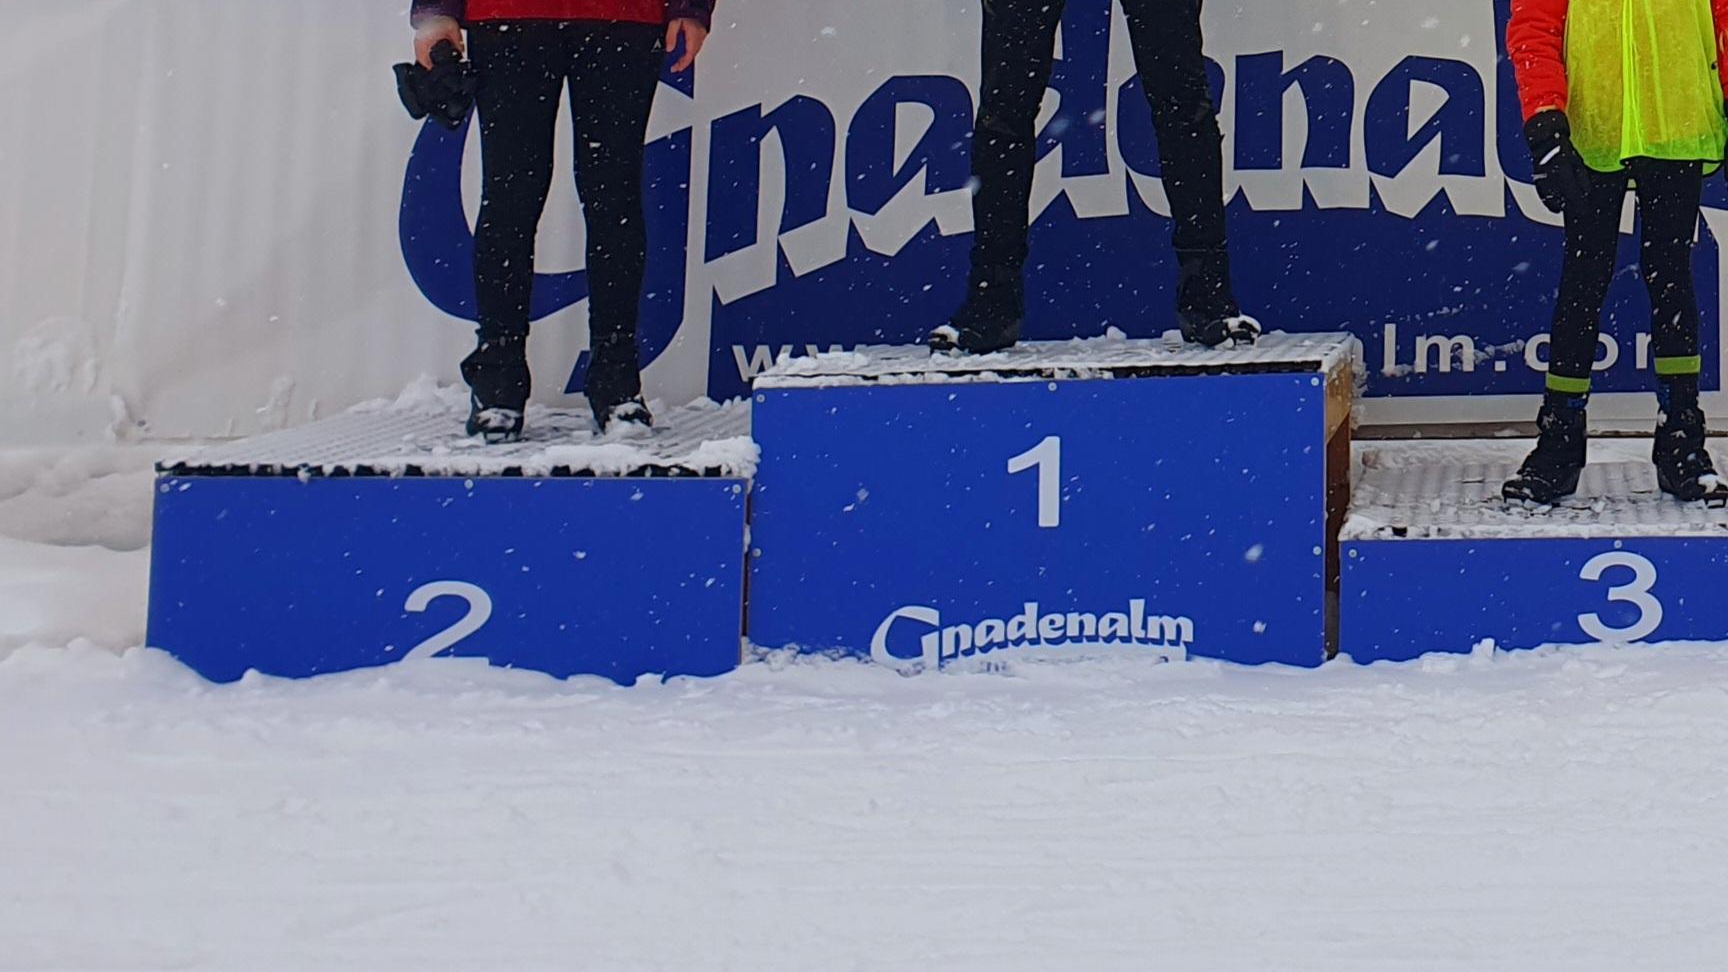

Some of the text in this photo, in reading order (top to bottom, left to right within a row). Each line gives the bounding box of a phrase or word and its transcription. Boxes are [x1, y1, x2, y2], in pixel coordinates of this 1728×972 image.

[1007, 436, 1060, 527] 1
[401, 580, 492, 668] 2
[870, 598, 1194, 673] Gnadenalm
[1577, 551, 1663, 643] 3
